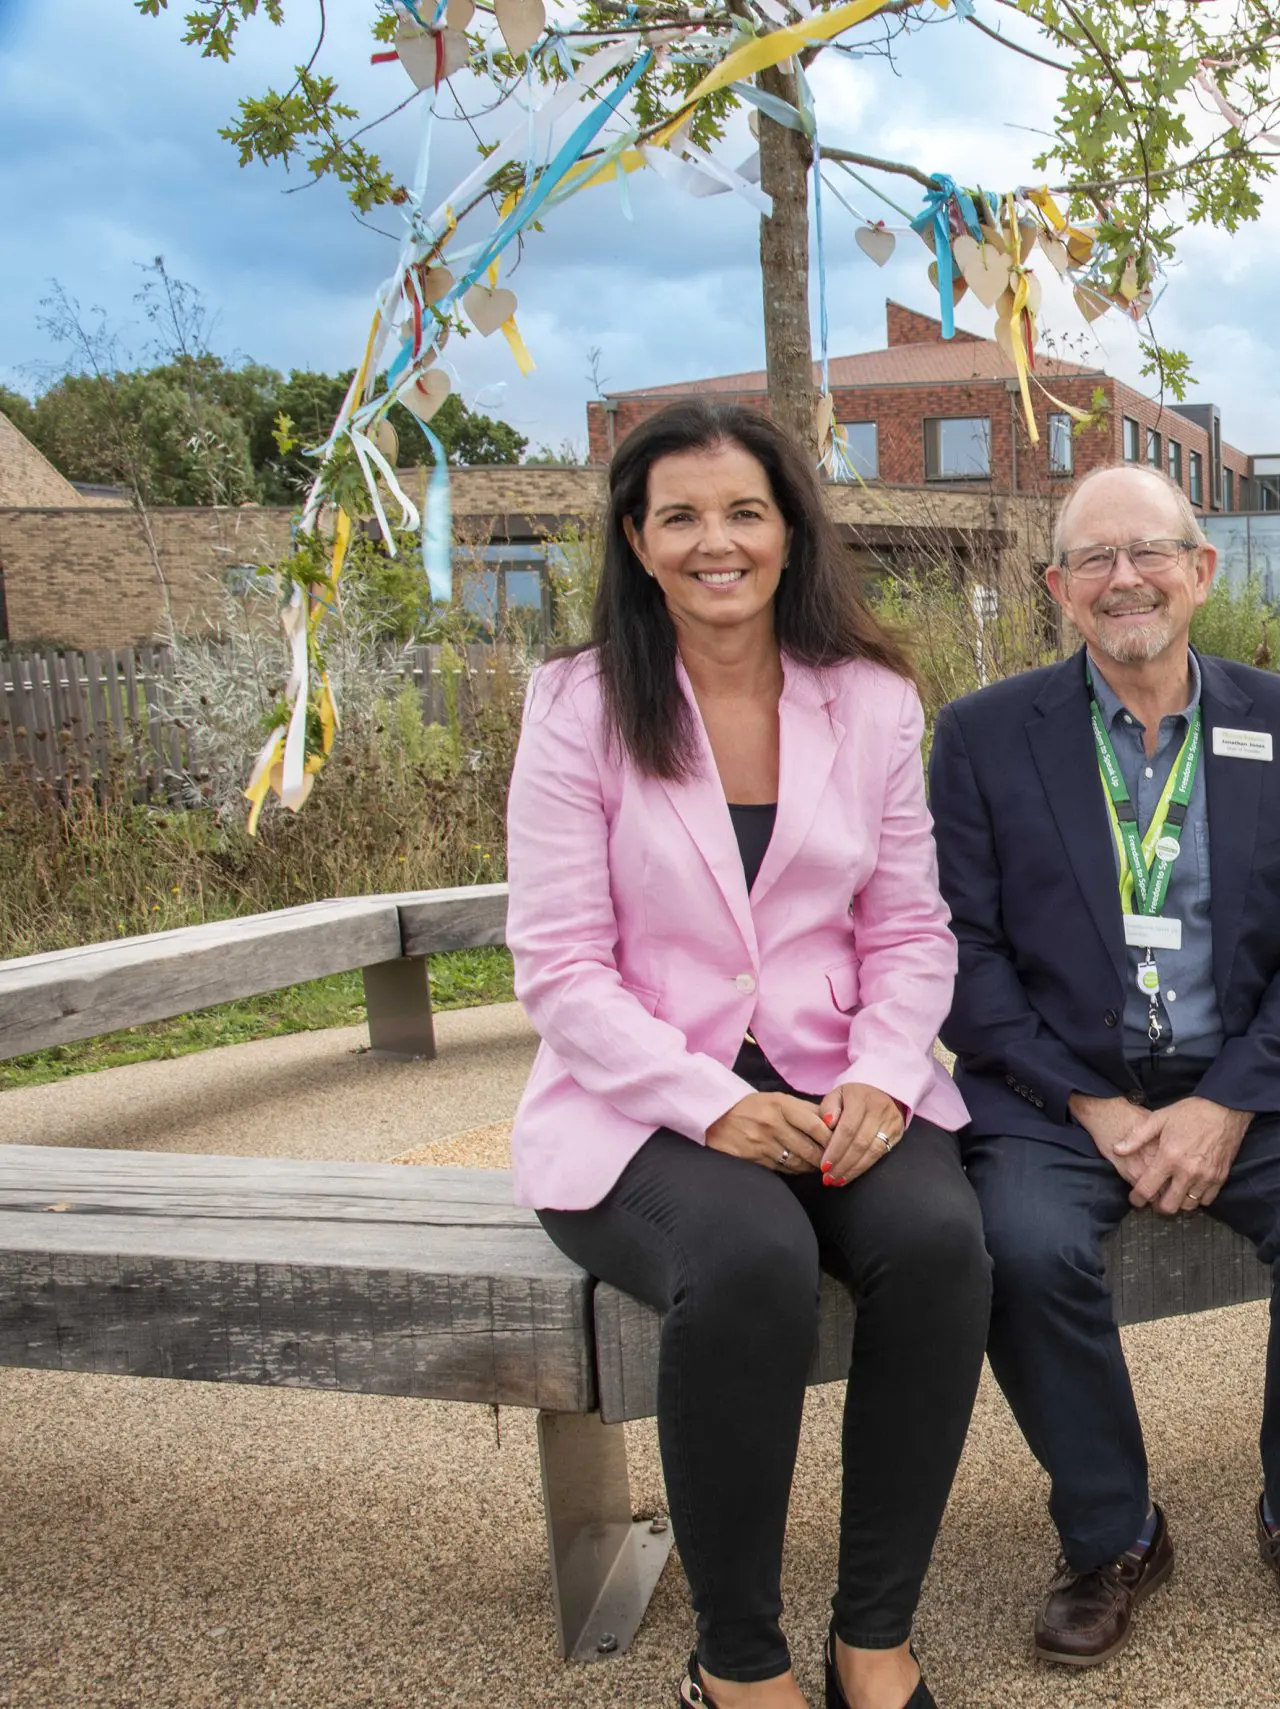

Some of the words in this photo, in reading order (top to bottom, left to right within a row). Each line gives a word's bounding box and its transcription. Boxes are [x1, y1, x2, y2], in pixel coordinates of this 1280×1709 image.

[1100, 745, 1107, 754] to
[1189, 732, 1199, 753] Speak
[1103, 754, 1116, 776] Speak
[1187, 752, 1194, 761] to
[1111, 776, 1119, 787] Up
[1179, 761, 1192, 793] Freedom
[1128, 835, 1141, 869] Freedom
[1137, 869, 1143, 878] to
[1149, 880, 1163, 914] Freedom
[1157, 871, 1165, 880] to
